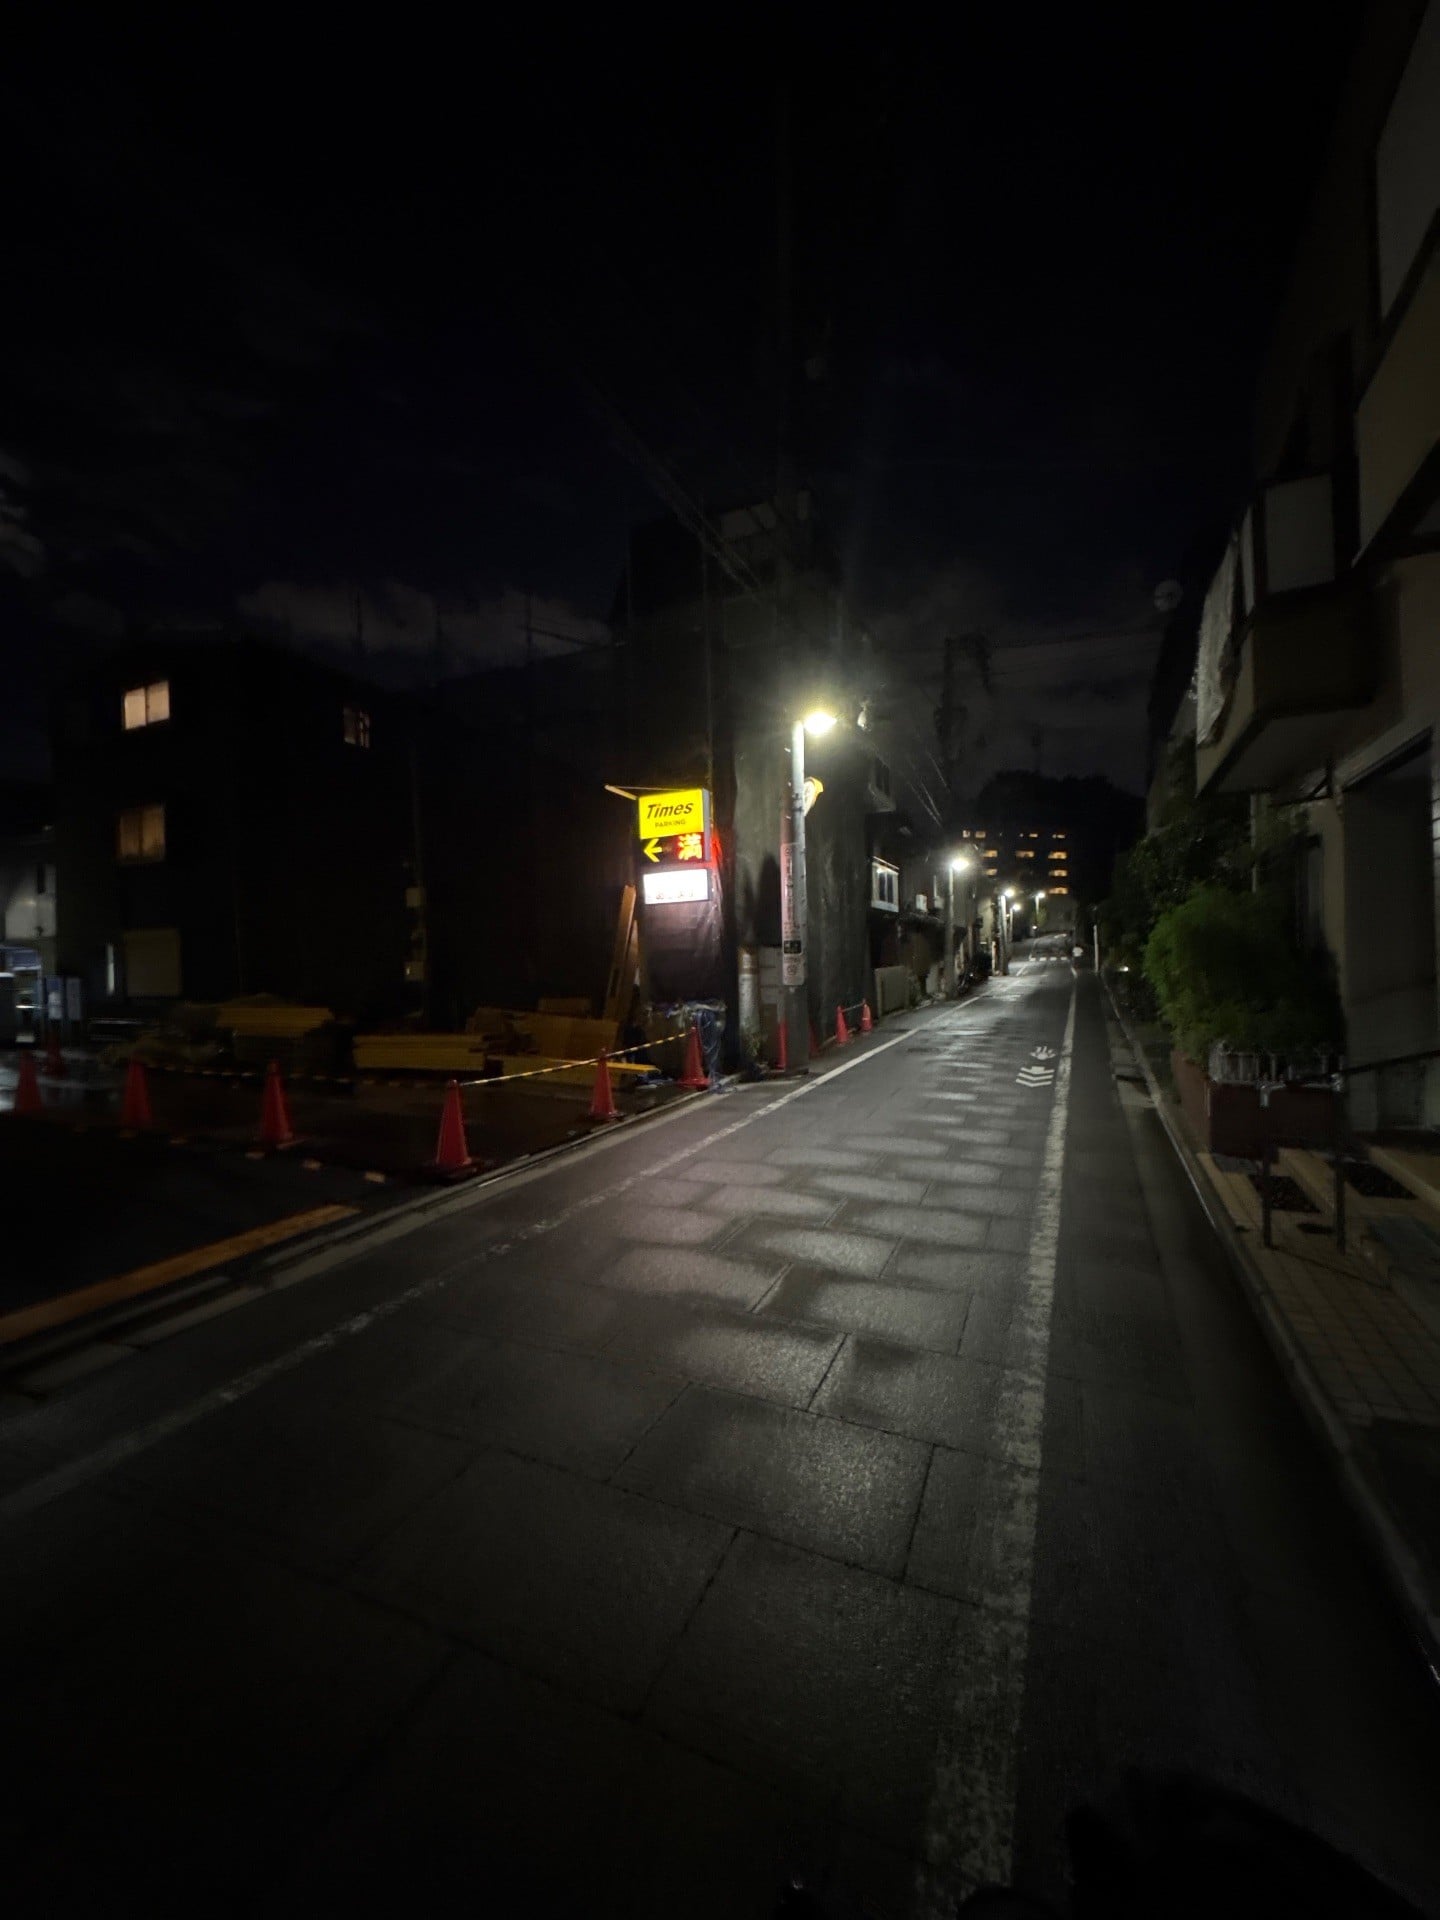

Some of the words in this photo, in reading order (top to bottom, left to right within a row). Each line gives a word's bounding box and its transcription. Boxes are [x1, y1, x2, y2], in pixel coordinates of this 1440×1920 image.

[647, 803, 694, 819] Times
[655, 819, 686, 828] PARKING
[678, 833, 702, 860] 満
